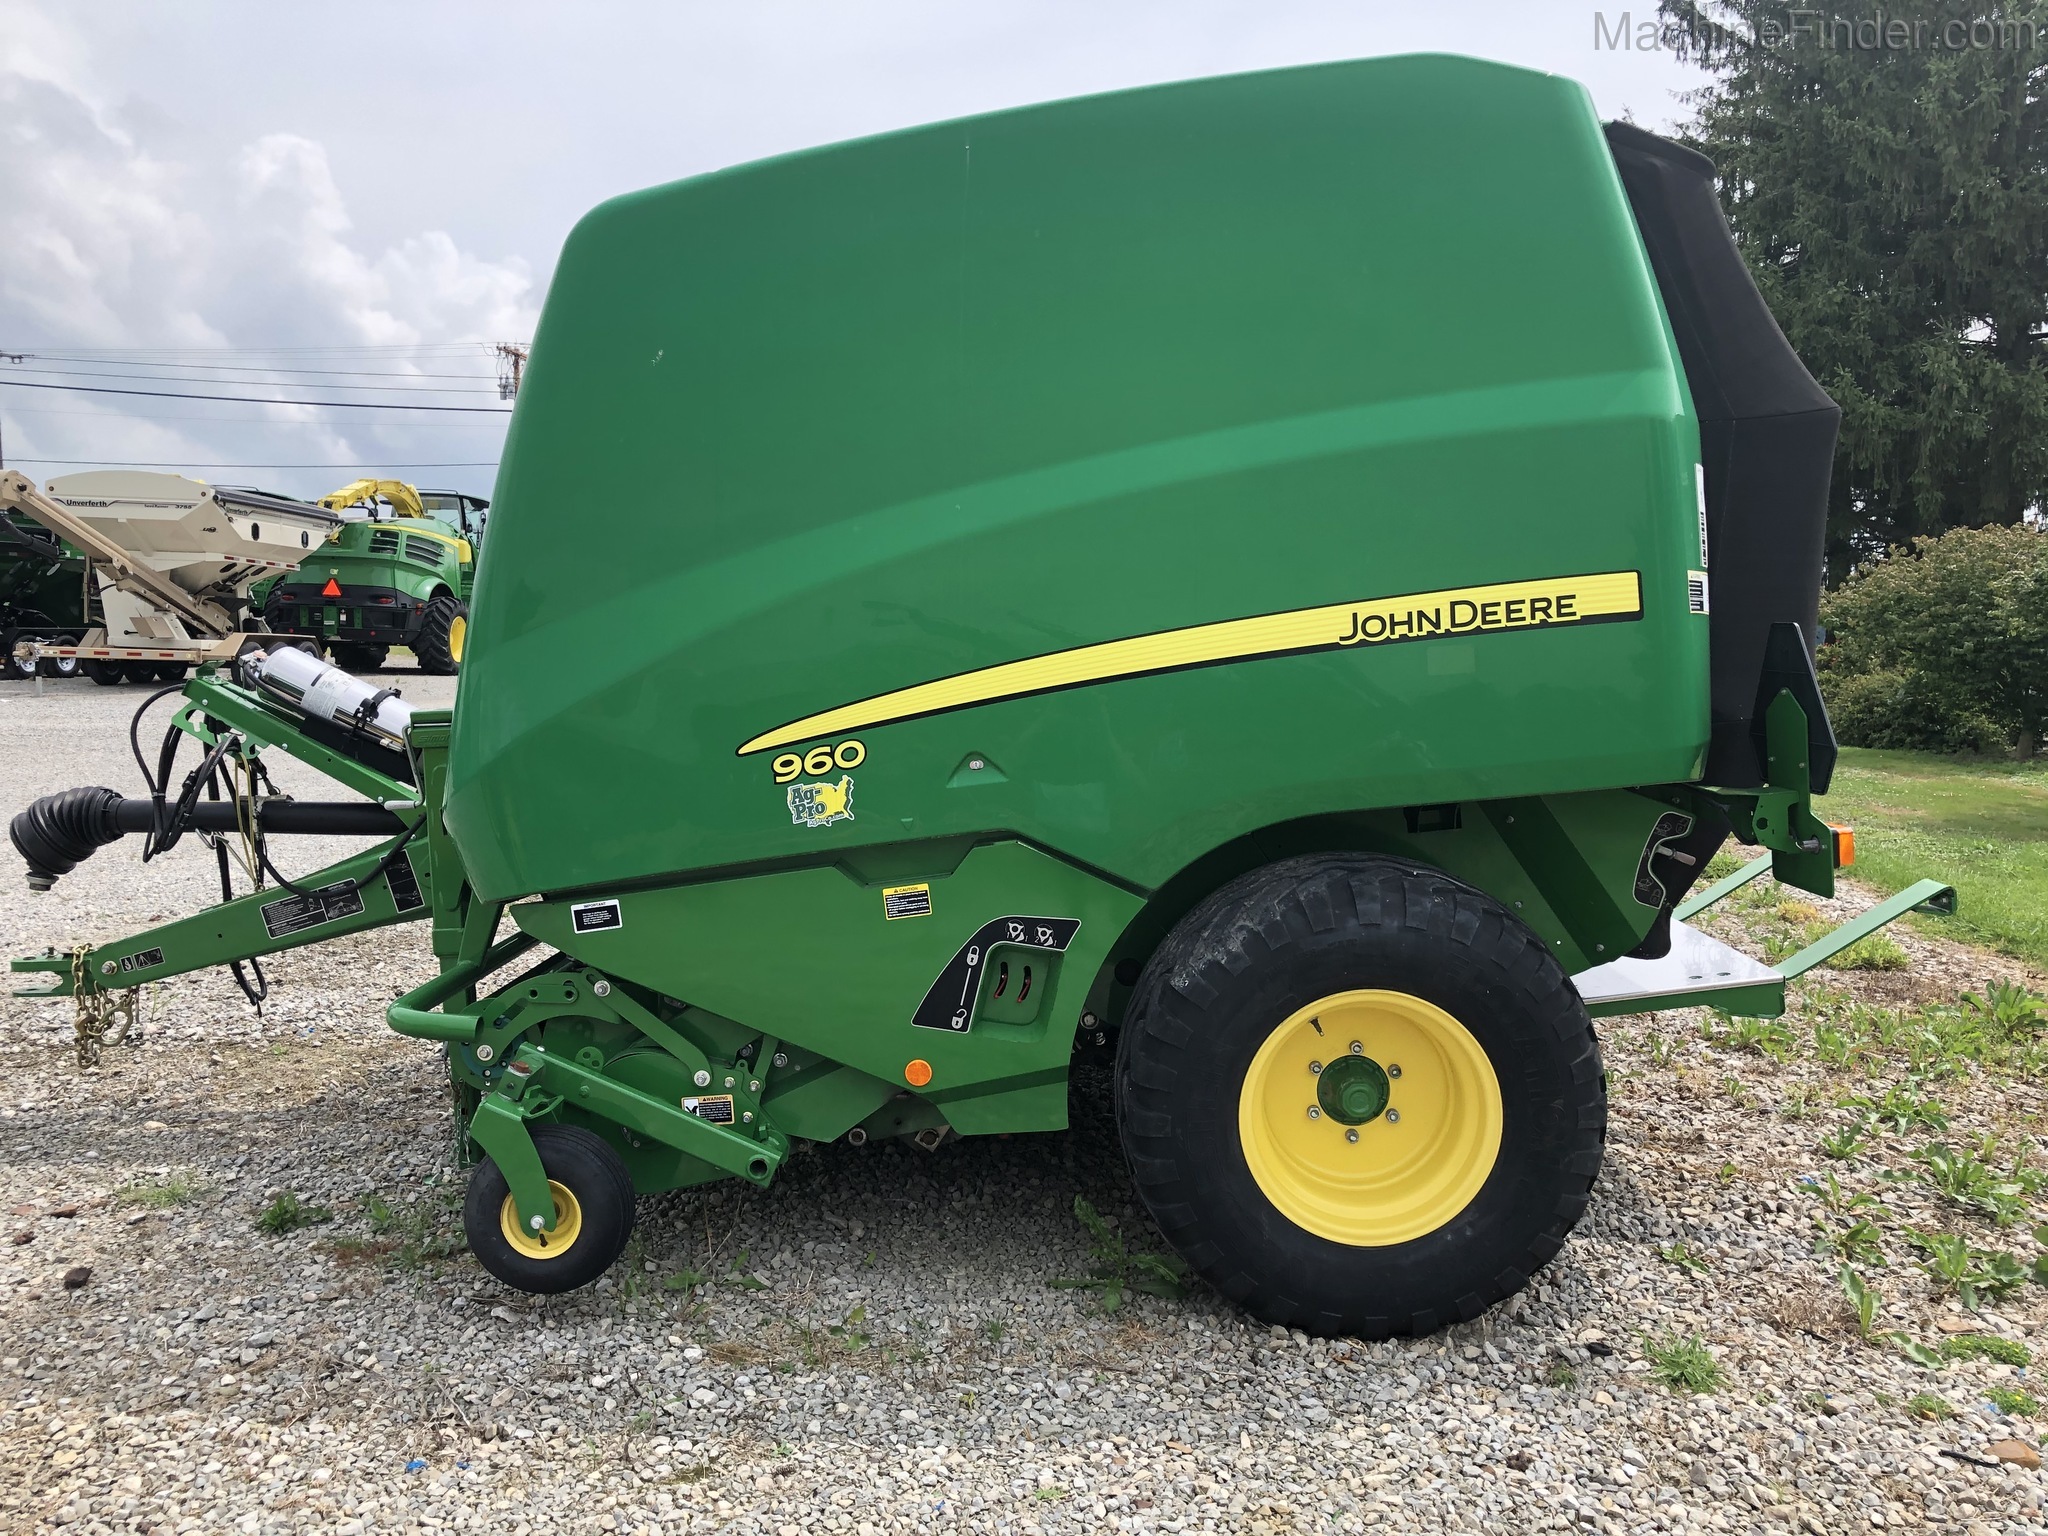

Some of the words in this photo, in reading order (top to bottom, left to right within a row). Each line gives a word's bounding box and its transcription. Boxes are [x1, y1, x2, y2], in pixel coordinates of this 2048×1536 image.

[66, 499, 107, 507] Unverferth
[1338, 607, 1441, 642] JOHN
[1449, 594, 1577, 629] DEERE
[771, 739, 867, 784] 960
[794, 802, 826, 821] Pro
